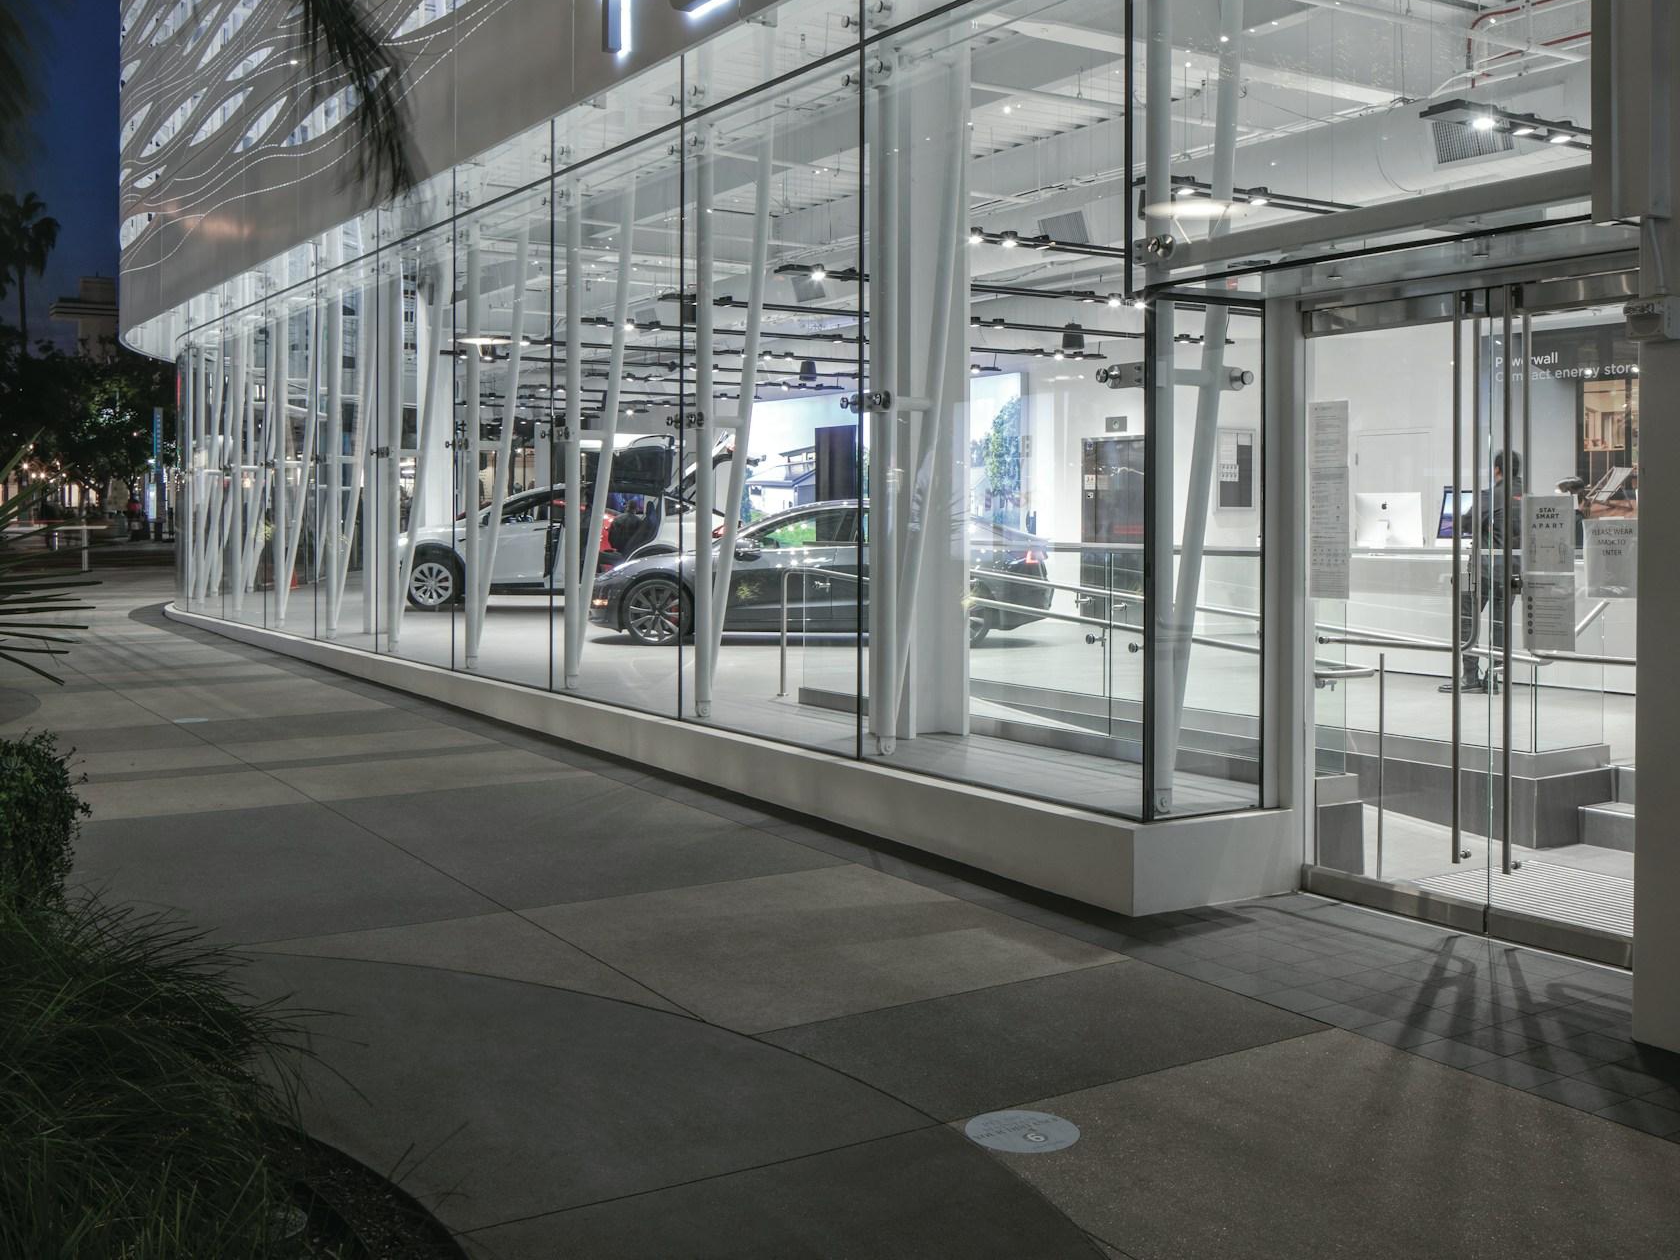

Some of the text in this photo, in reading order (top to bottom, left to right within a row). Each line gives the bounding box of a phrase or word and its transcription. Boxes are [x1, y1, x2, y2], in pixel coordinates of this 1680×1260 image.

[1495, 351, 1559, 367] Pwwall
[1495, 368, 1552, 382] Cmact
[1555, 367, 1600, 379] energy
[1613, 527, 1633, 535] WEAR
